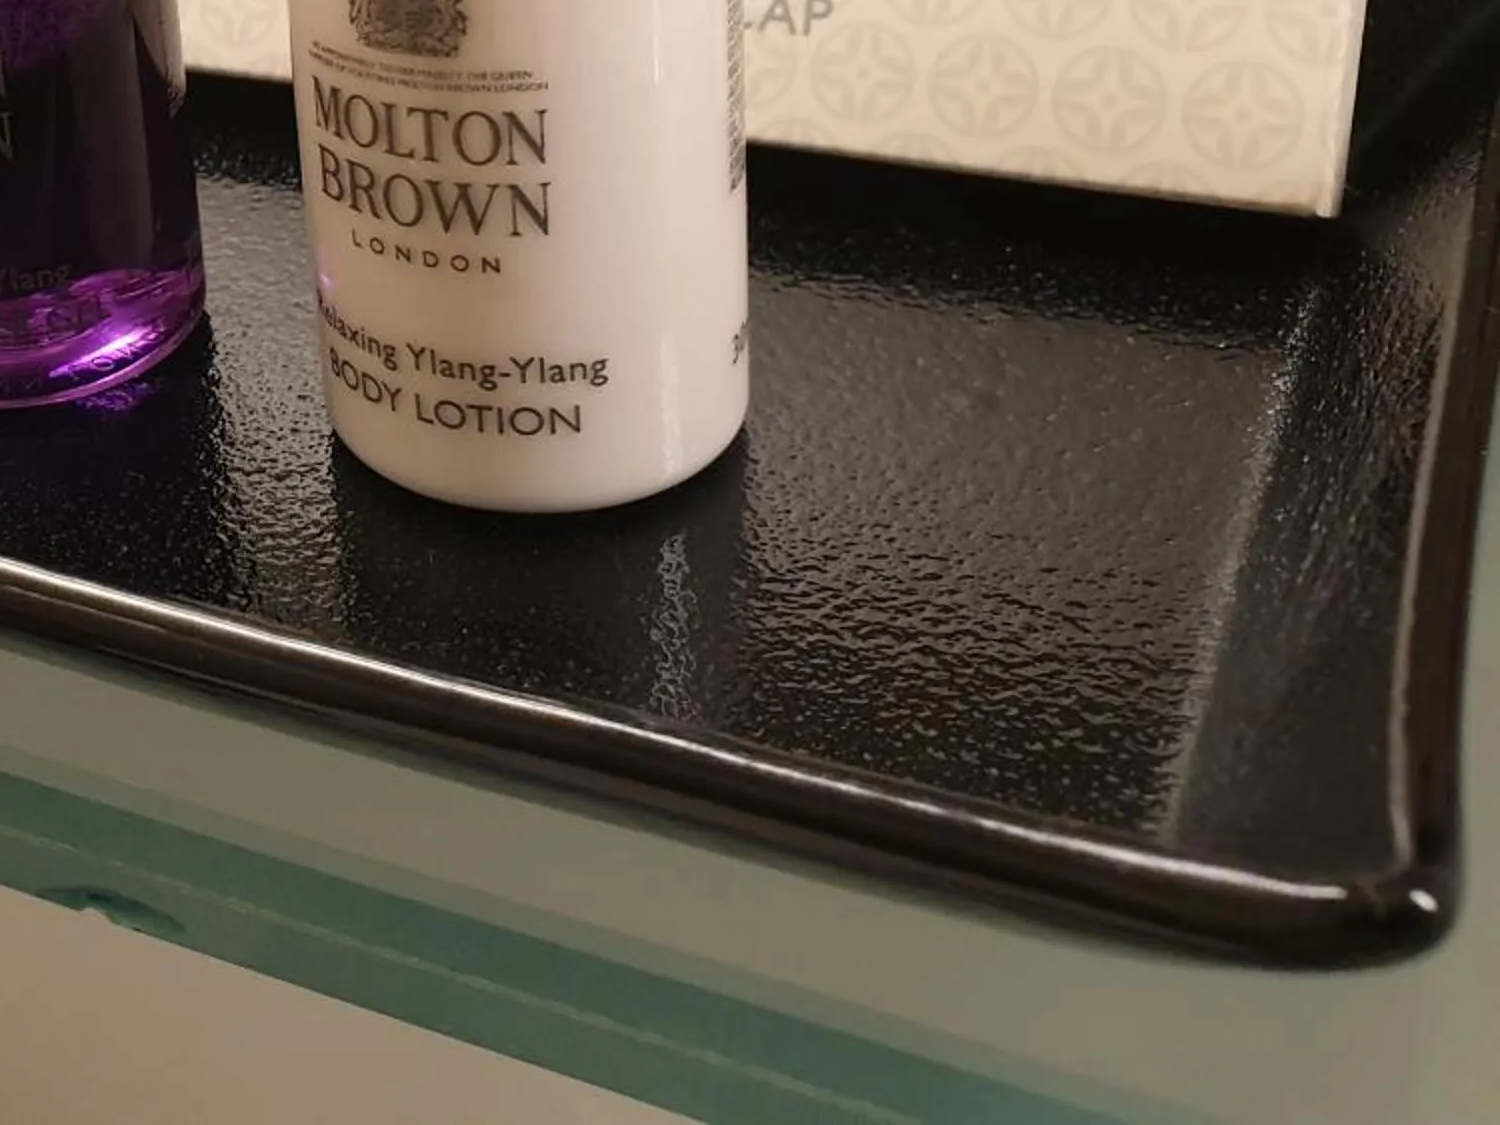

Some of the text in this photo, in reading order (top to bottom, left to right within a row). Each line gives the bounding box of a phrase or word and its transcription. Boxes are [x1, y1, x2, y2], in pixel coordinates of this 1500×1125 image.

[312, 75, 548, 166] MOLTON
[318, 143, 551, 237] BROWN
[352, 228, 501, 273] LONDON
[329, 347, 581, 436] BODY LOTION
[406, 342, 610, 392] Ylang-Ylang
